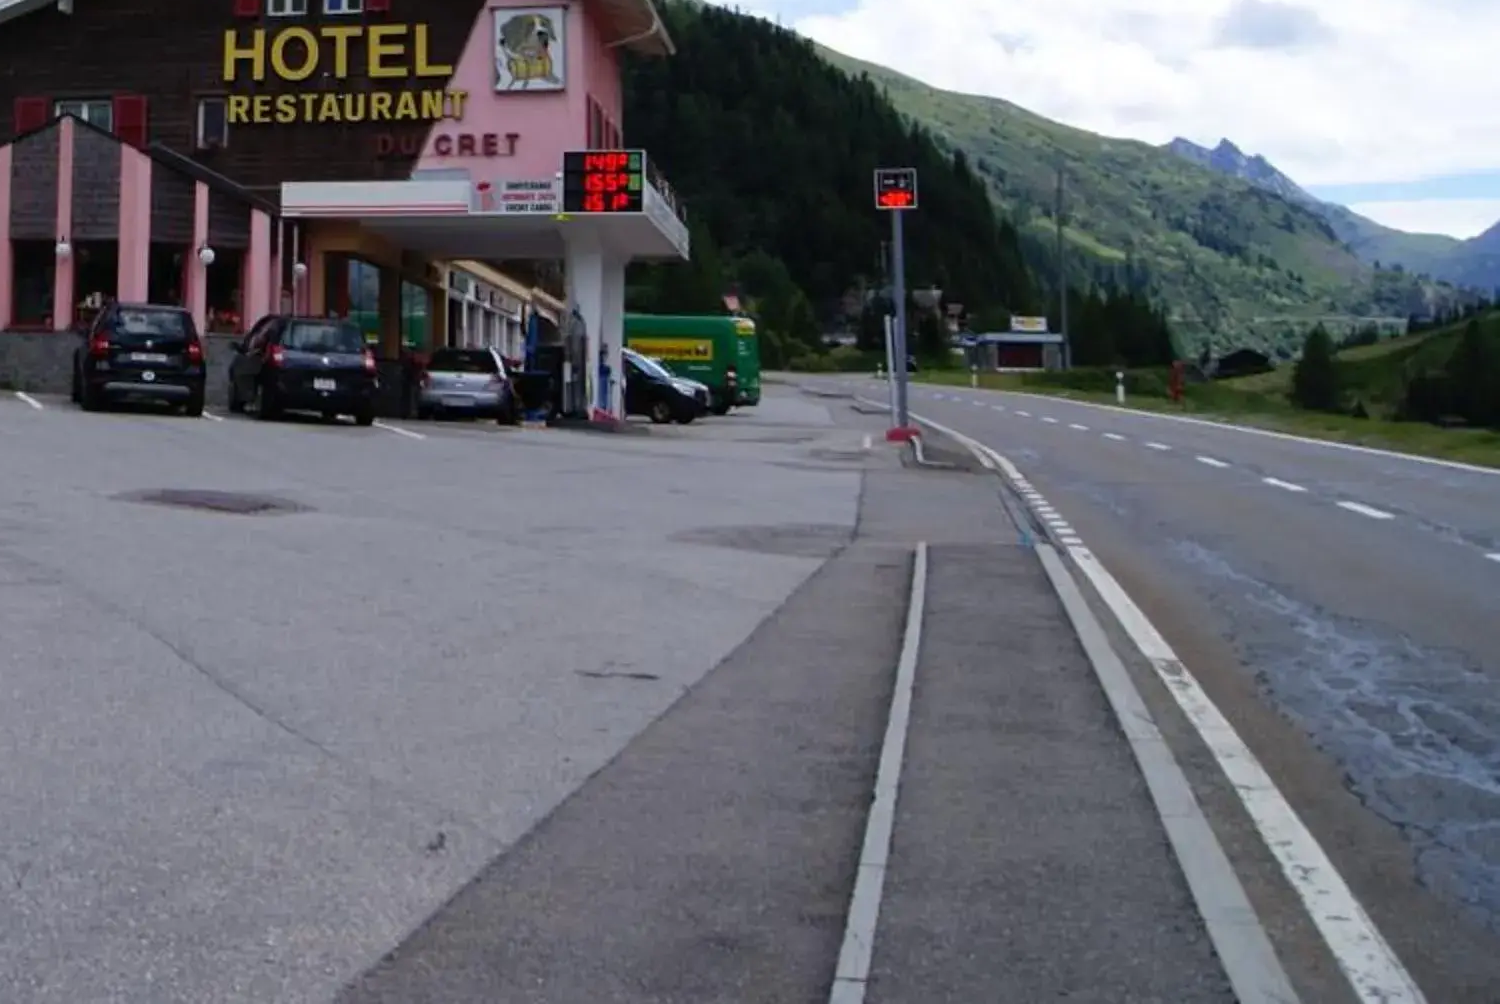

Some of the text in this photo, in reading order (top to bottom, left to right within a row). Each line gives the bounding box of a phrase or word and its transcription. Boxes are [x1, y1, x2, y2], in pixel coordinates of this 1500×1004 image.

[223, 23, 453, 81] HOTEL
[227, 89, 467, 124] RESTAURANT
[434, 132, 520, 157] CRET
